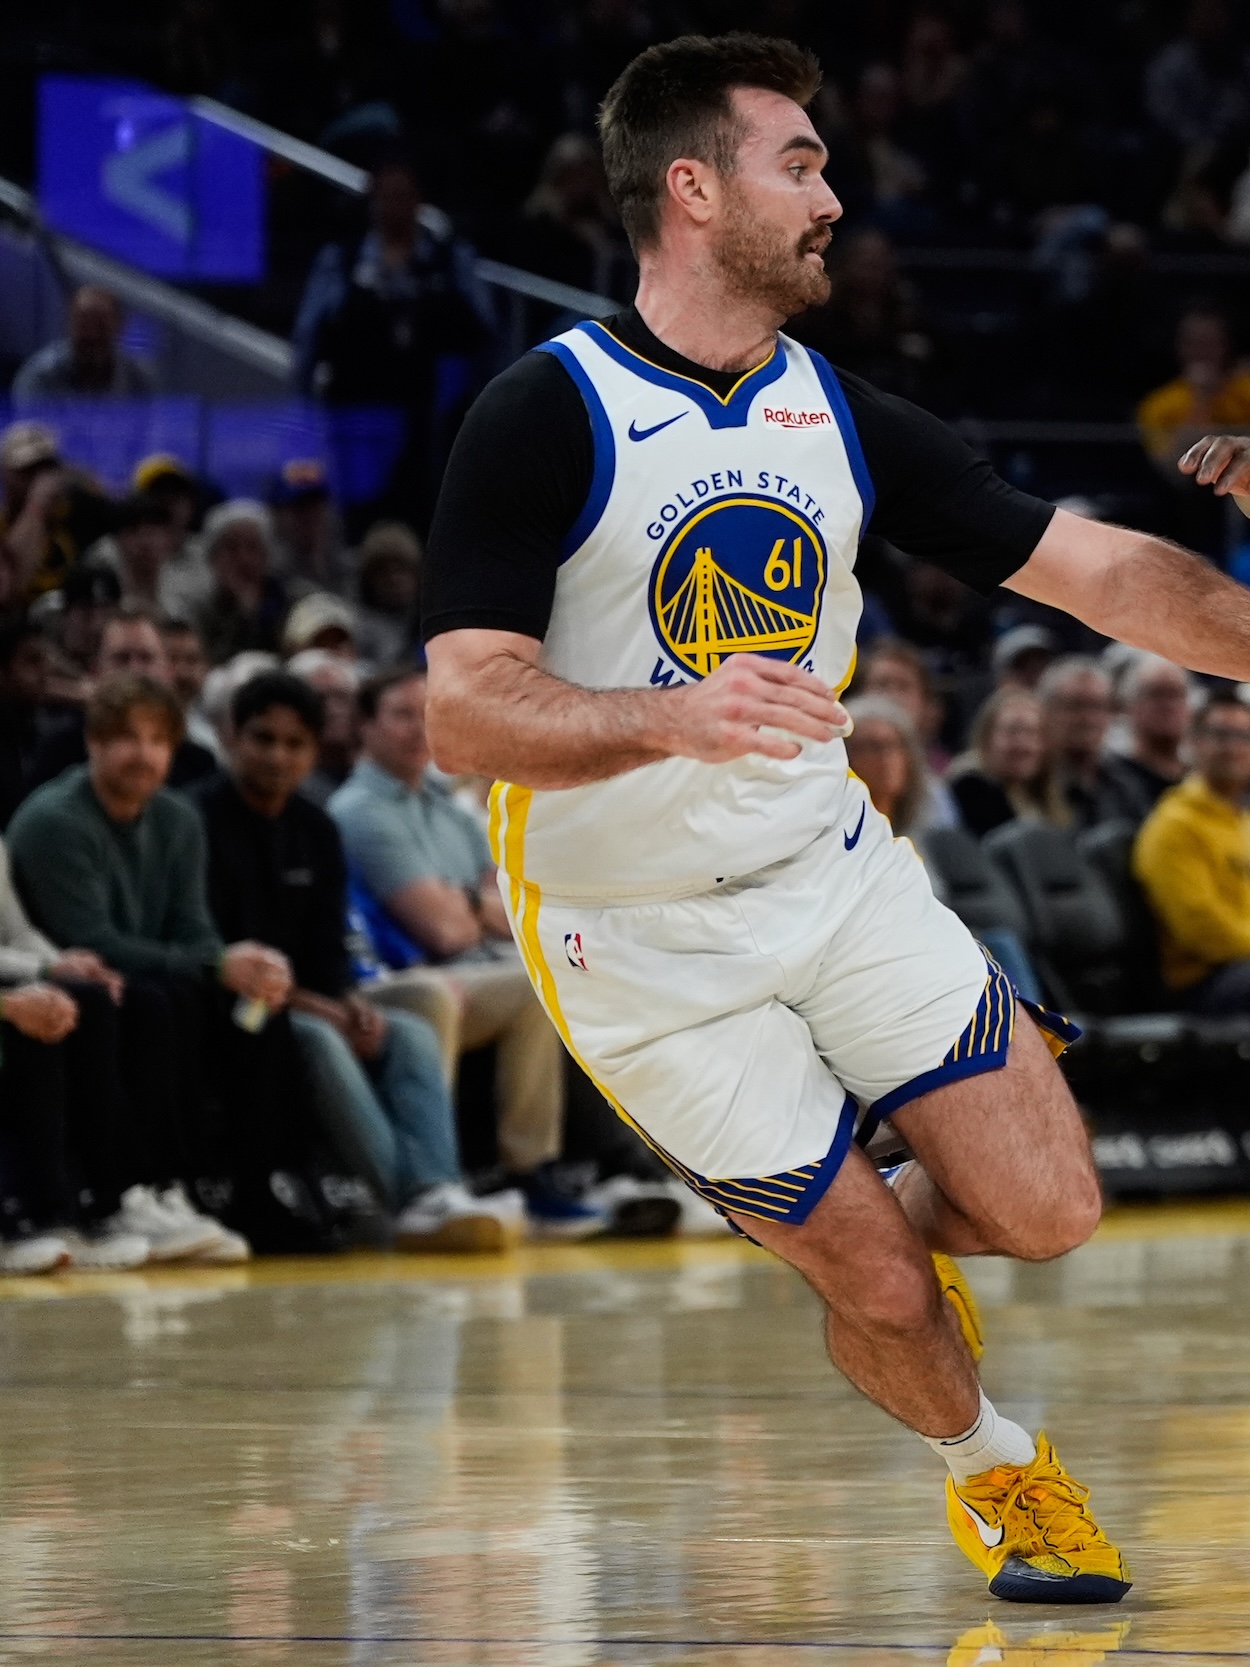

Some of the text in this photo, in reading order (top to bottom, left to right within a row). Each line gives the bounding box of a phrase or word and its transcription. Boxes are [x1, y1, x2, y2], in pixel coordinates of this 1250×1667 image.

[763, 408, 831, 427] Rakuten
[646, 469, 825, 541] GOLDEN STATE
[763, 536, 802, 592] 61
